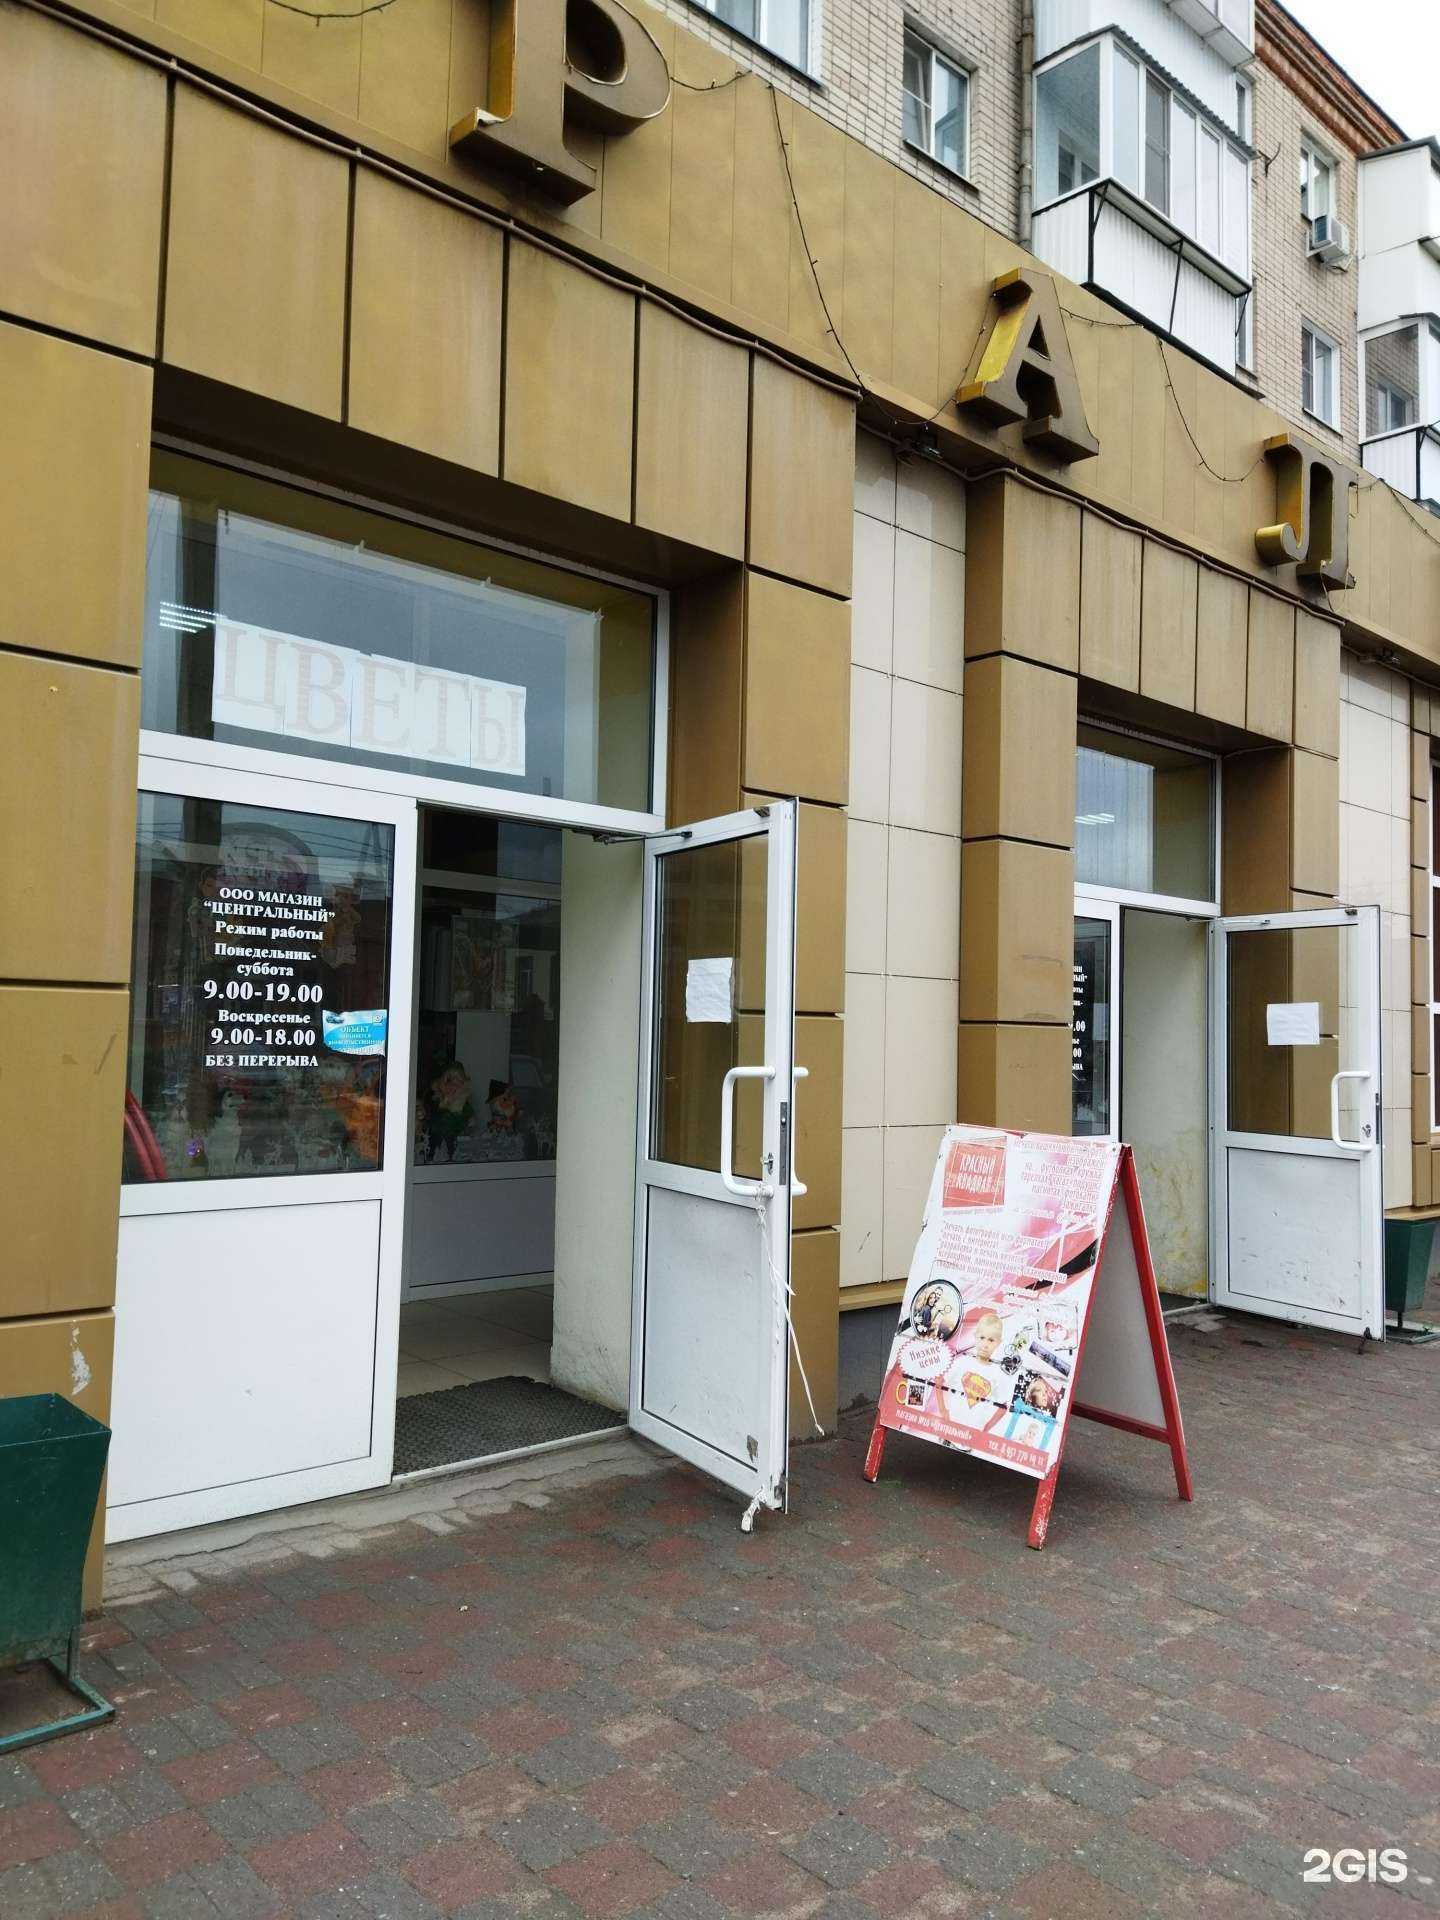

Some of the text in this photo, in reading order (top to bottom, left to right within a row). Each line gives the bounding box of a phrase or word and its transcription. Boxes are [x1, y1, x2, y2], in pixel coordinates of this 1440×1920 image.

[219, 624, 524, 767] ЦВЕТЫ
[219, 887, 323, 907] ООО МАГАЗИН
[215, 921, 324, 941] Режим работы
[214, 943, 317, 961] Понедельник-
[236, 962, 295, 977] суббота
[203, 980, 324, 1004] 9.00-19.00
[218, 1009, 311, 1024] Воскресенье
[210, 1028, 316, 1047] 9.00-18.00
[205, 1055, 319, 1067] БЕЗ ПЕРЕРЫВА
[960, 1152, 996, 1173] КРАСНЫЙ
[909, 1345, 941, 1361] Низкие
[919, 1356, 941, 1369] цены
